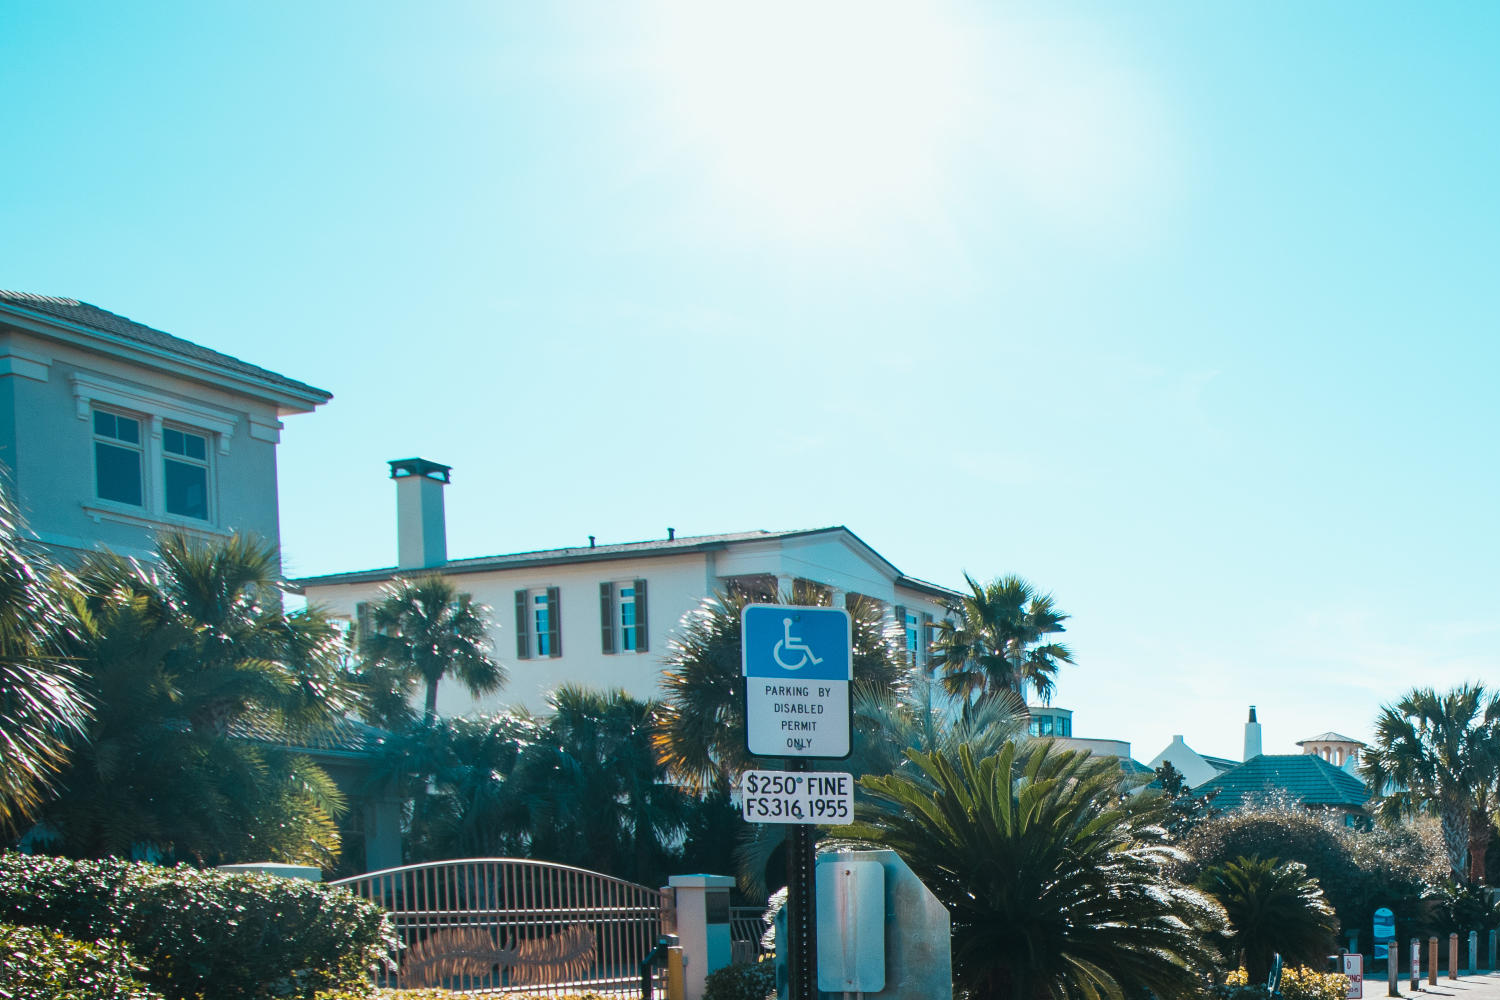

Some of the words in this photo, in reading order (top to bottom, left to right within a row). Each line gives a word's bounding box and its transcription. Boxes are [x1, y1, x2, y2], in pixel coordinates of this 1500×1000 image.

[765, 685, 809, 697] PARKING
[818, 687, 831, 697] BY
[774, 703, 824, 714] DISABLED
[781, 721, 817, 731] PERMIT
[786, 738, 812, 749] ONLY
[746, 772, 797, 795] $250
[807, 777, 848, 796] FINE
